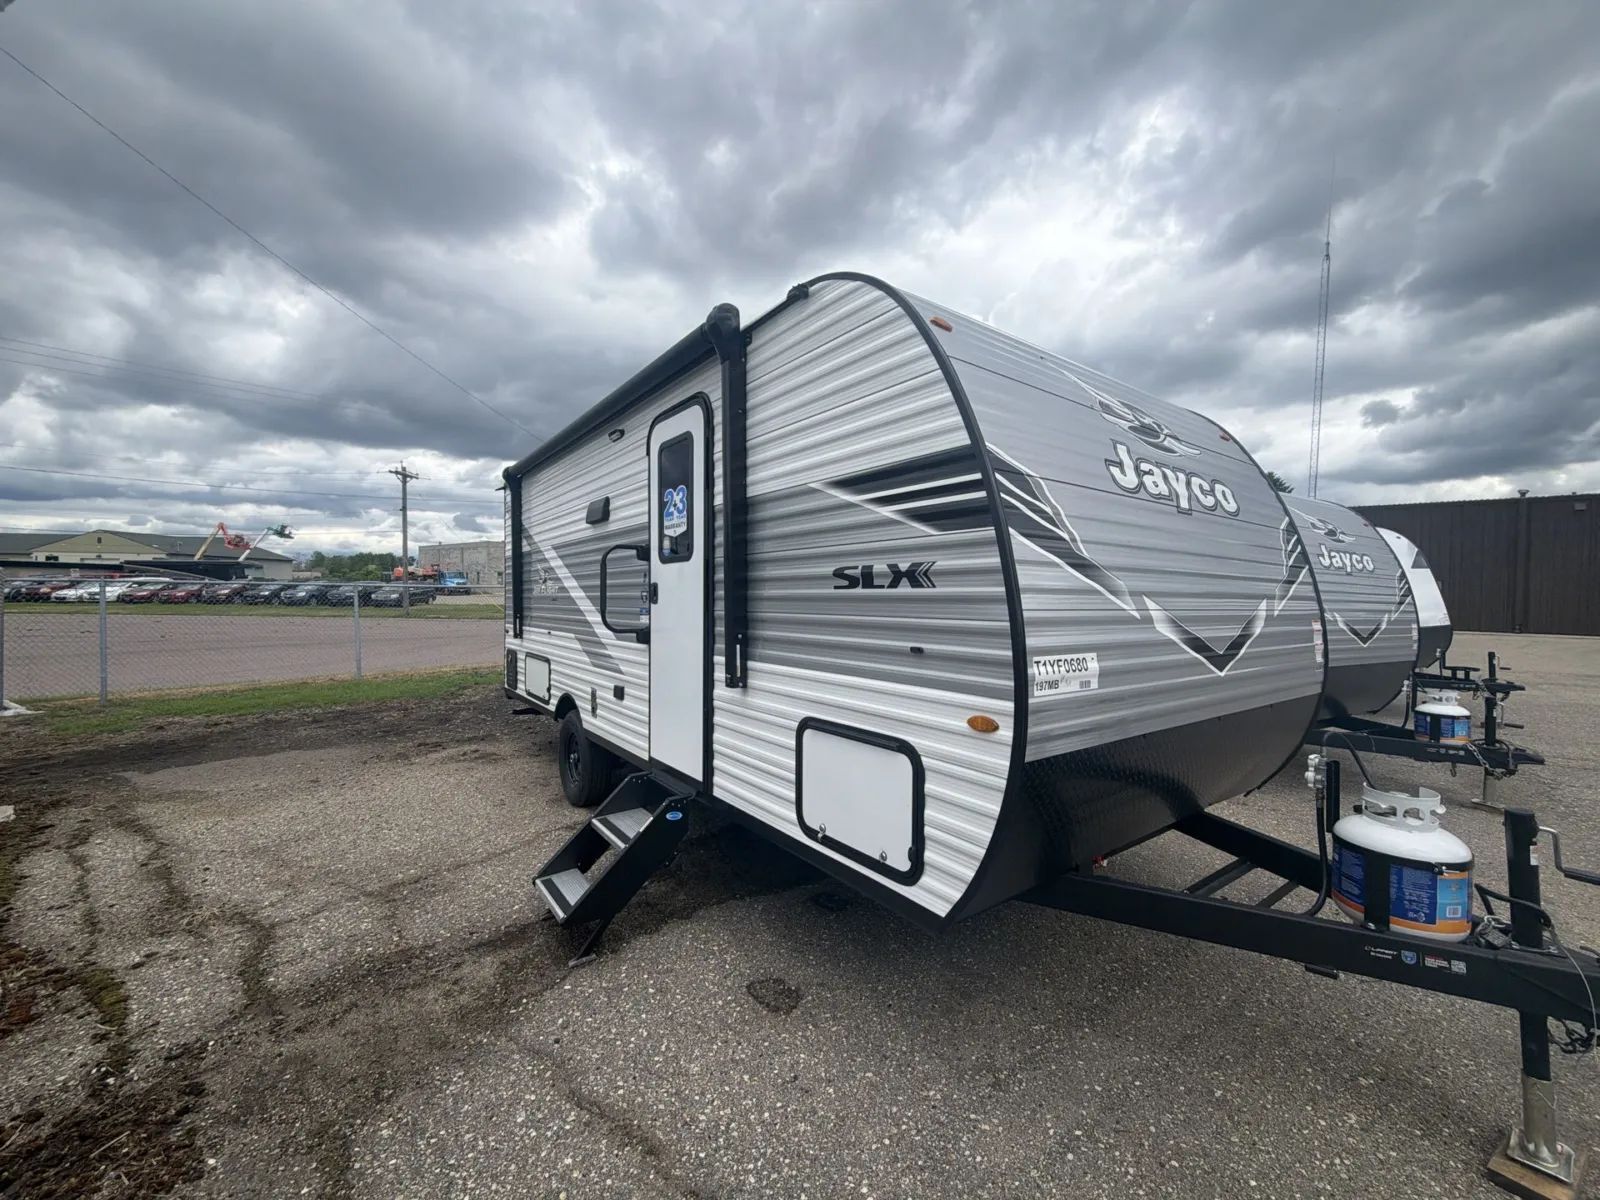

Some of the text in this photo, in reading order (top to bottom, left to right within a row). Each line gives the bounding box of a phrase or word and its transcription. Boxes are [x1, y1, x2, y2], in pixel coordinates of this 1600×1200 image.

[1105, 440, 1239, 515] Jayco
[1318, 543, 1375, 574] Jayco
[832, 561, 937, 589] SLX
[1034, 657, 1089, 676] T1YF0680
[1035, 679, 1060, 691] 197MB
